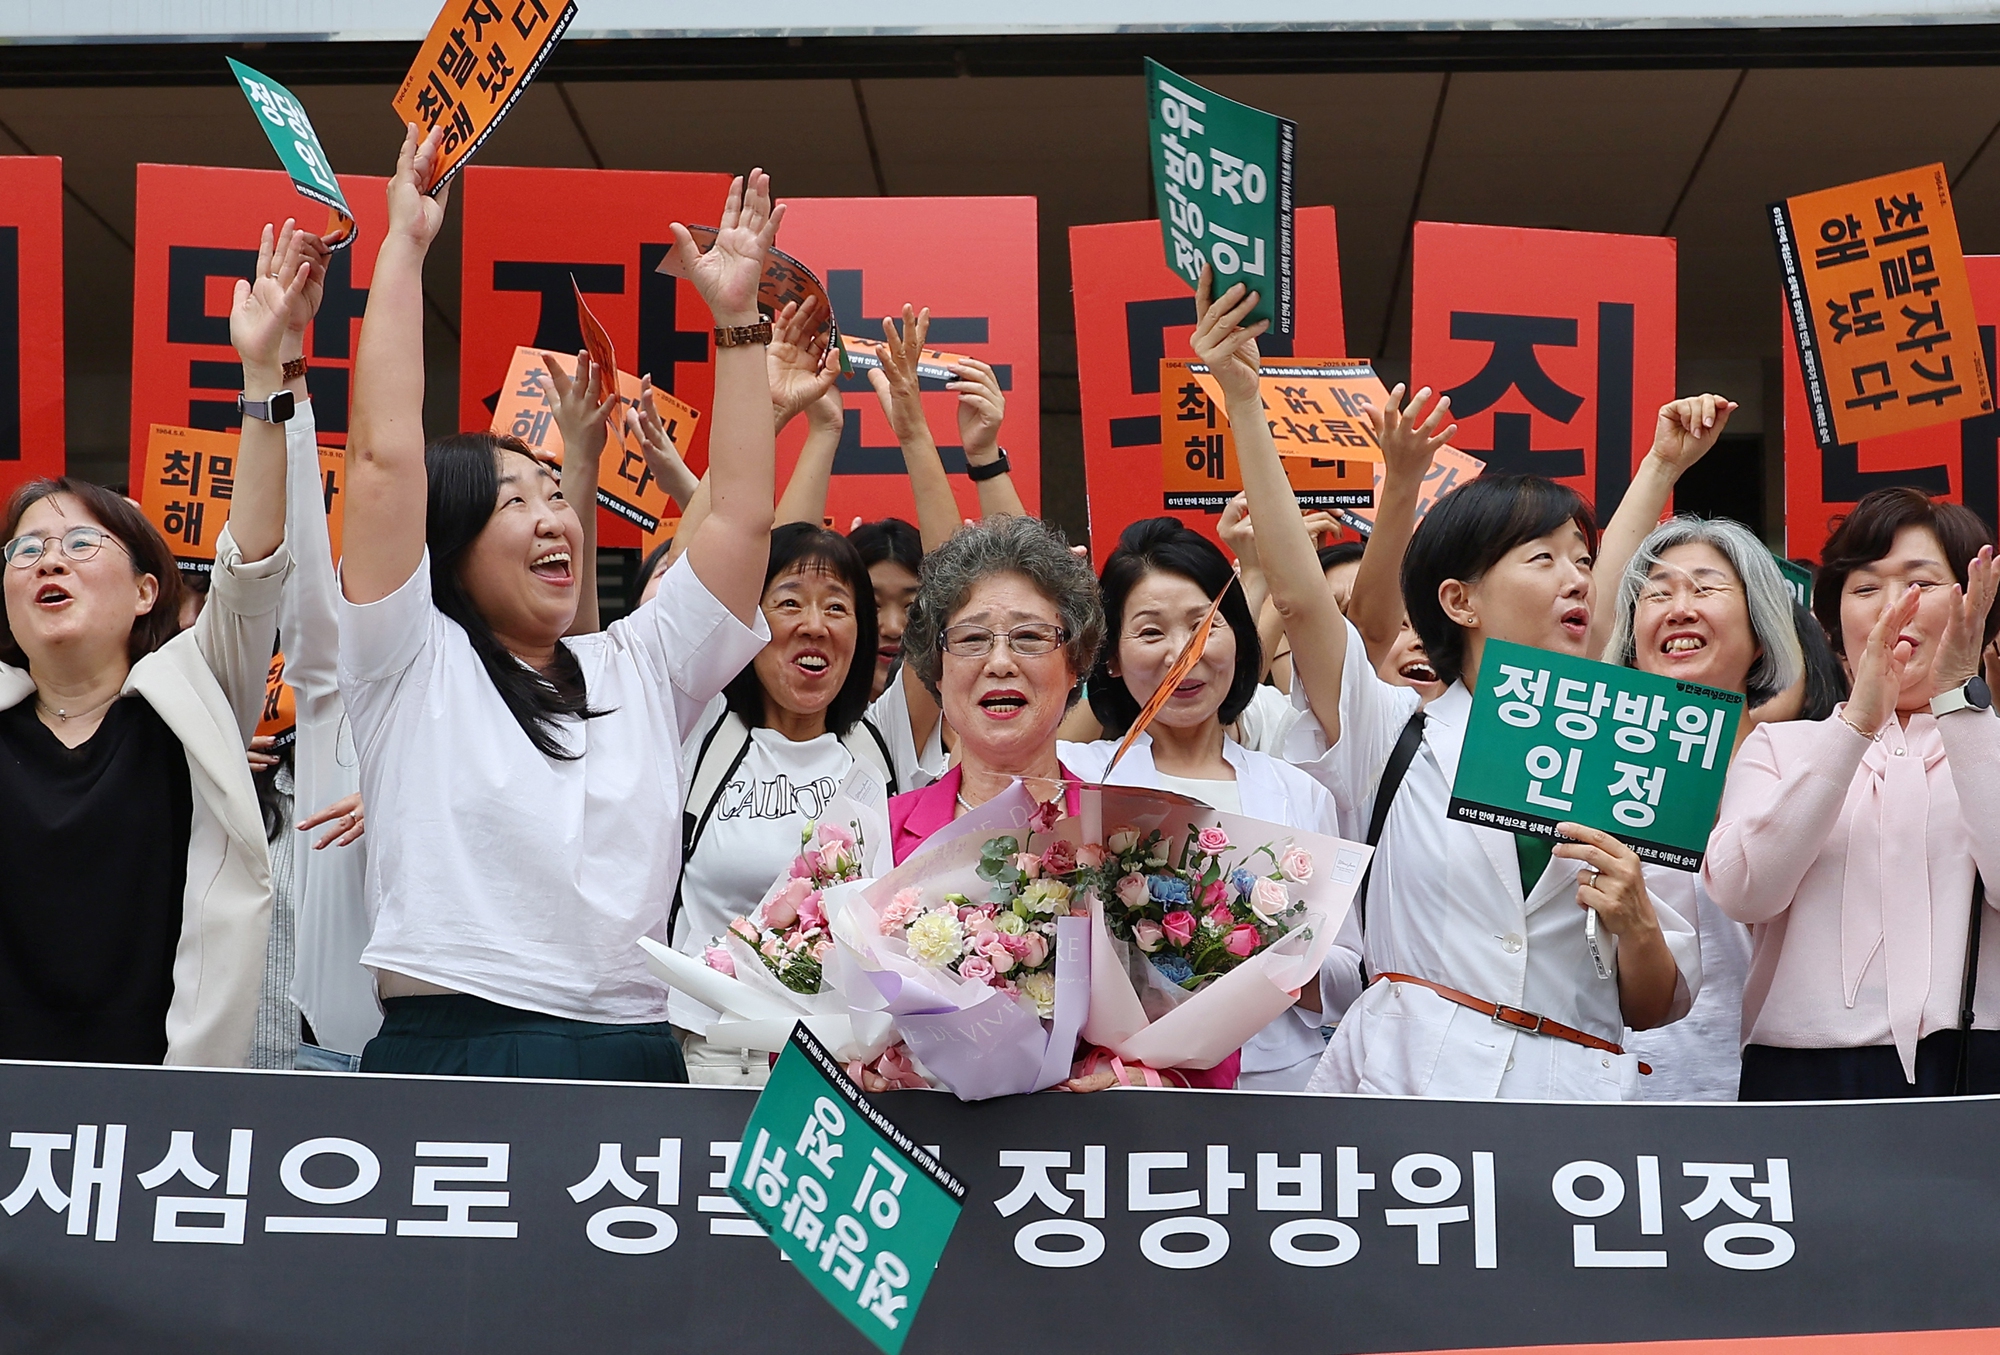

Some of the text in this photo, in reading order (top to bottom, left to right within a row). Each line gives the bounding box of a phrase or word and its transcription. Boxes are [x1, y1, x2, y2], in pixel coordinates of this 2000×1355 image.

[1873, 191, 1963, 407] 최말자가
[1184, 434, 1225, 480] 해
[1440, 301, 1635, 530] 죄
[163, 501, 204, 546] 해
[1493, 664, 1726, 770] 정당방위
[1458, 807, 1478, 819] 61년
[1478, 811, 1496, 822] 만에
[1496, 815, 1528, 830] 재심으로
[1529, 823, 1553, 836] 성폭력
[1636, 846, 1658, 859] 최초로
[1659, 851, 1682, 864] 이뤄낸
[1682, 857, 1698, 868] 승리
[2, 1124, 519, 1244] 재심으로
[994, 1145, 1796, 1270] 정당방위 인정
